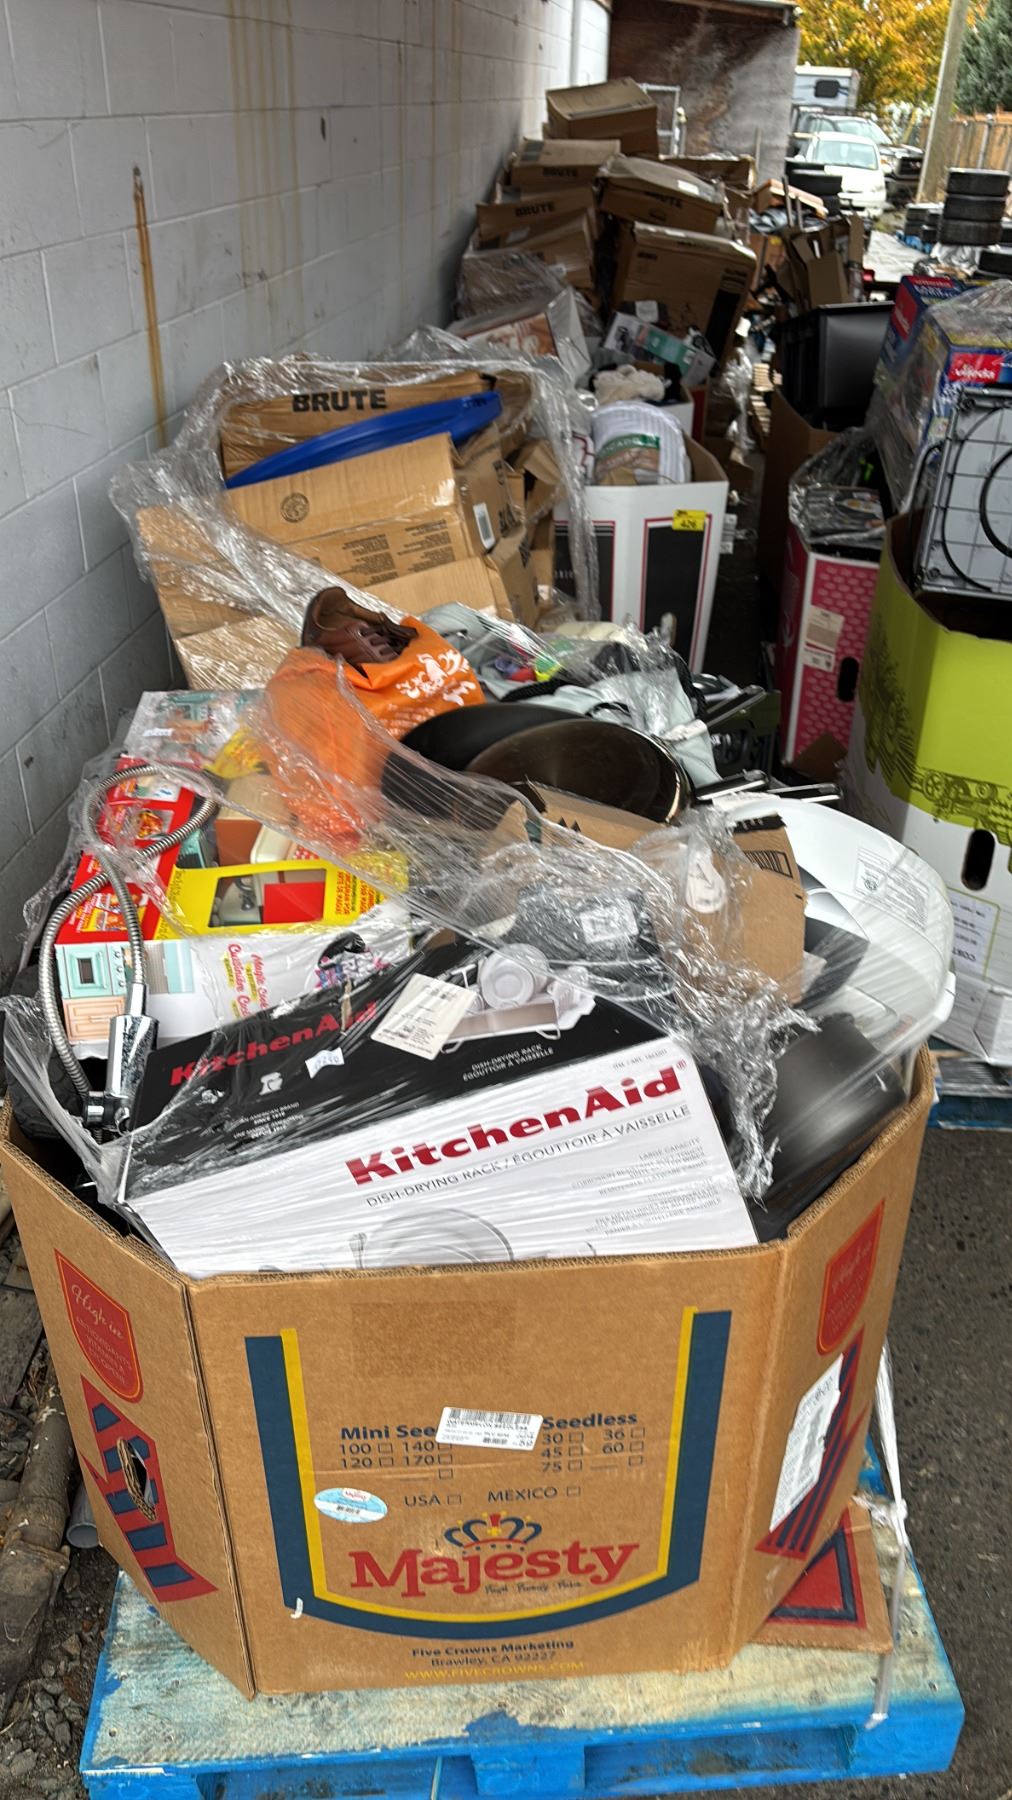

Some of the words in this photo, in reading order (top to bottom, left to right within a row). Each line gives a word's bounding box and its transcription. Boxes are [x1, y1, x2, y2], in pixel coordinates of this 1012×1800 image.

[514, 201, 556, 217] BRUTE
[292, 389, 388, 412] BRUTE
[521, 1043, 543, 1055] RACK
[366, 1171, 460, 1207] DISH-DRYING
[462, 1161, 501, 1181] RACK
[511, 1132, 598, 1168] ÉGOUTTOIR
[613, 1104, 692, 1135] VAISSELLE
[542, 1412, 638, 1429] Seedless
[340, 1425, 391, 1441] Mini
[542, 1432, 564, 1444] 30
[603, 1428, 625, 1441] 36
[339, 1444, 372, 1456] 100
[402, 1441, 435, 1453] 140
[541, 1446, 563, 1459] 45
[602, 1442, 625, 1455] 60
[341, 1457, 373, 1469] 120
[402, 1454, 435, 1466] 170
[541, 1460, 562, 1473] 75
[404, 1495, 441, 1508] USA
[488, 1486, 558, 1503] MEXICO
[348, 1540, 640, 1598] Majesty
[411, 1648, 441, 1658] Five
[444, 1645, 498, 1656] Crowns
[501, 1639, 574, 1654] Marketing
[491, 1654, 511, 1664] CA
[404, 1661, 585, 1681] WWW.FIVECROWNS.COM
